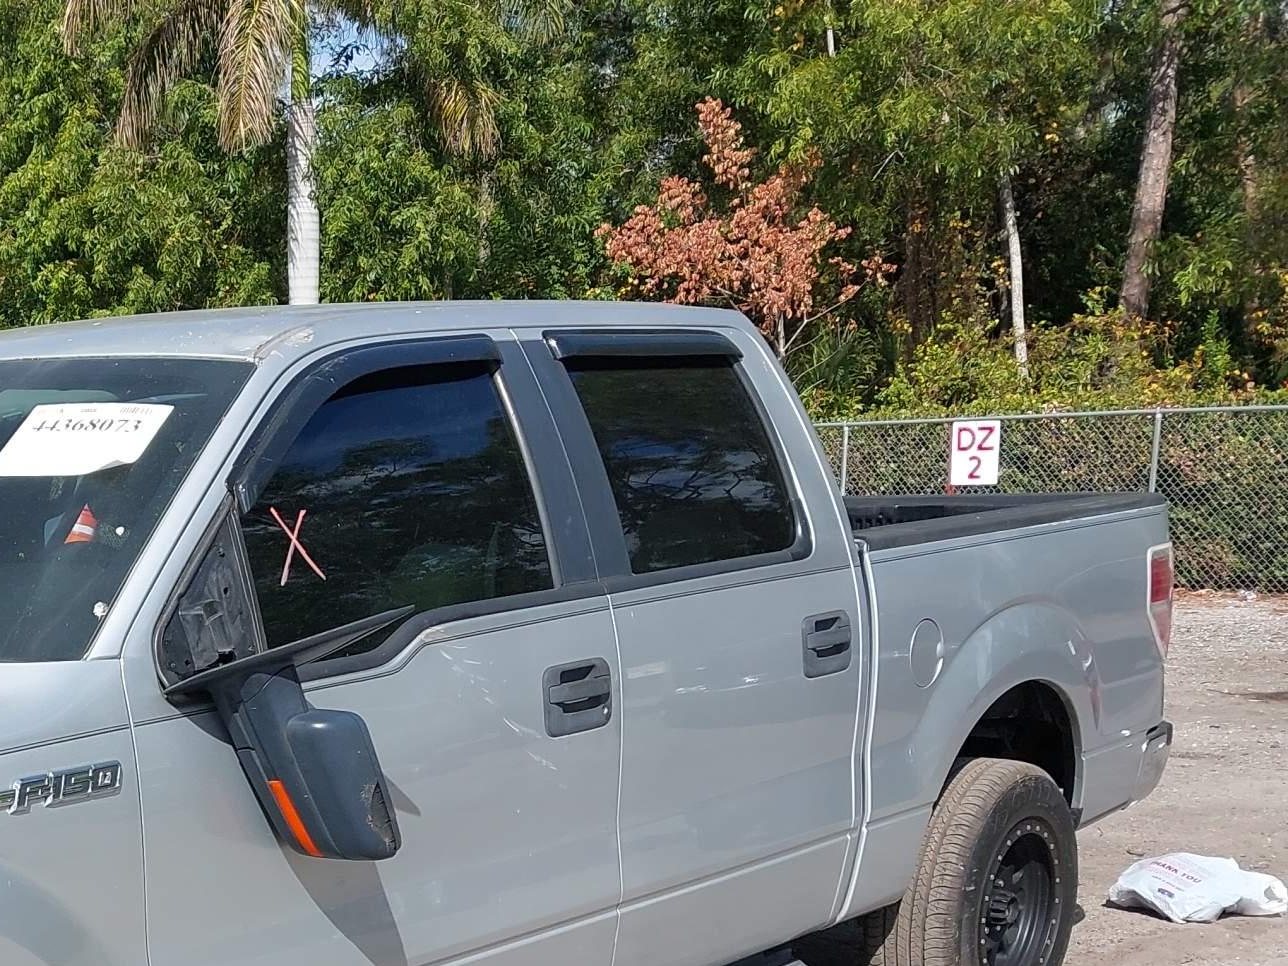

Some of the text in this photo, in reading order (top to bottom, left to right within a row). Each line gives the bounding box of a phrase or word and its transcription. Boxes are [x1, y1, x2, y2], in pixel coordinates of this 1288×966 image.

[32, 418, 142, 433] 44368073
[957, 426, 995, 451] DZ
[968, 455, 982, 479] 2
